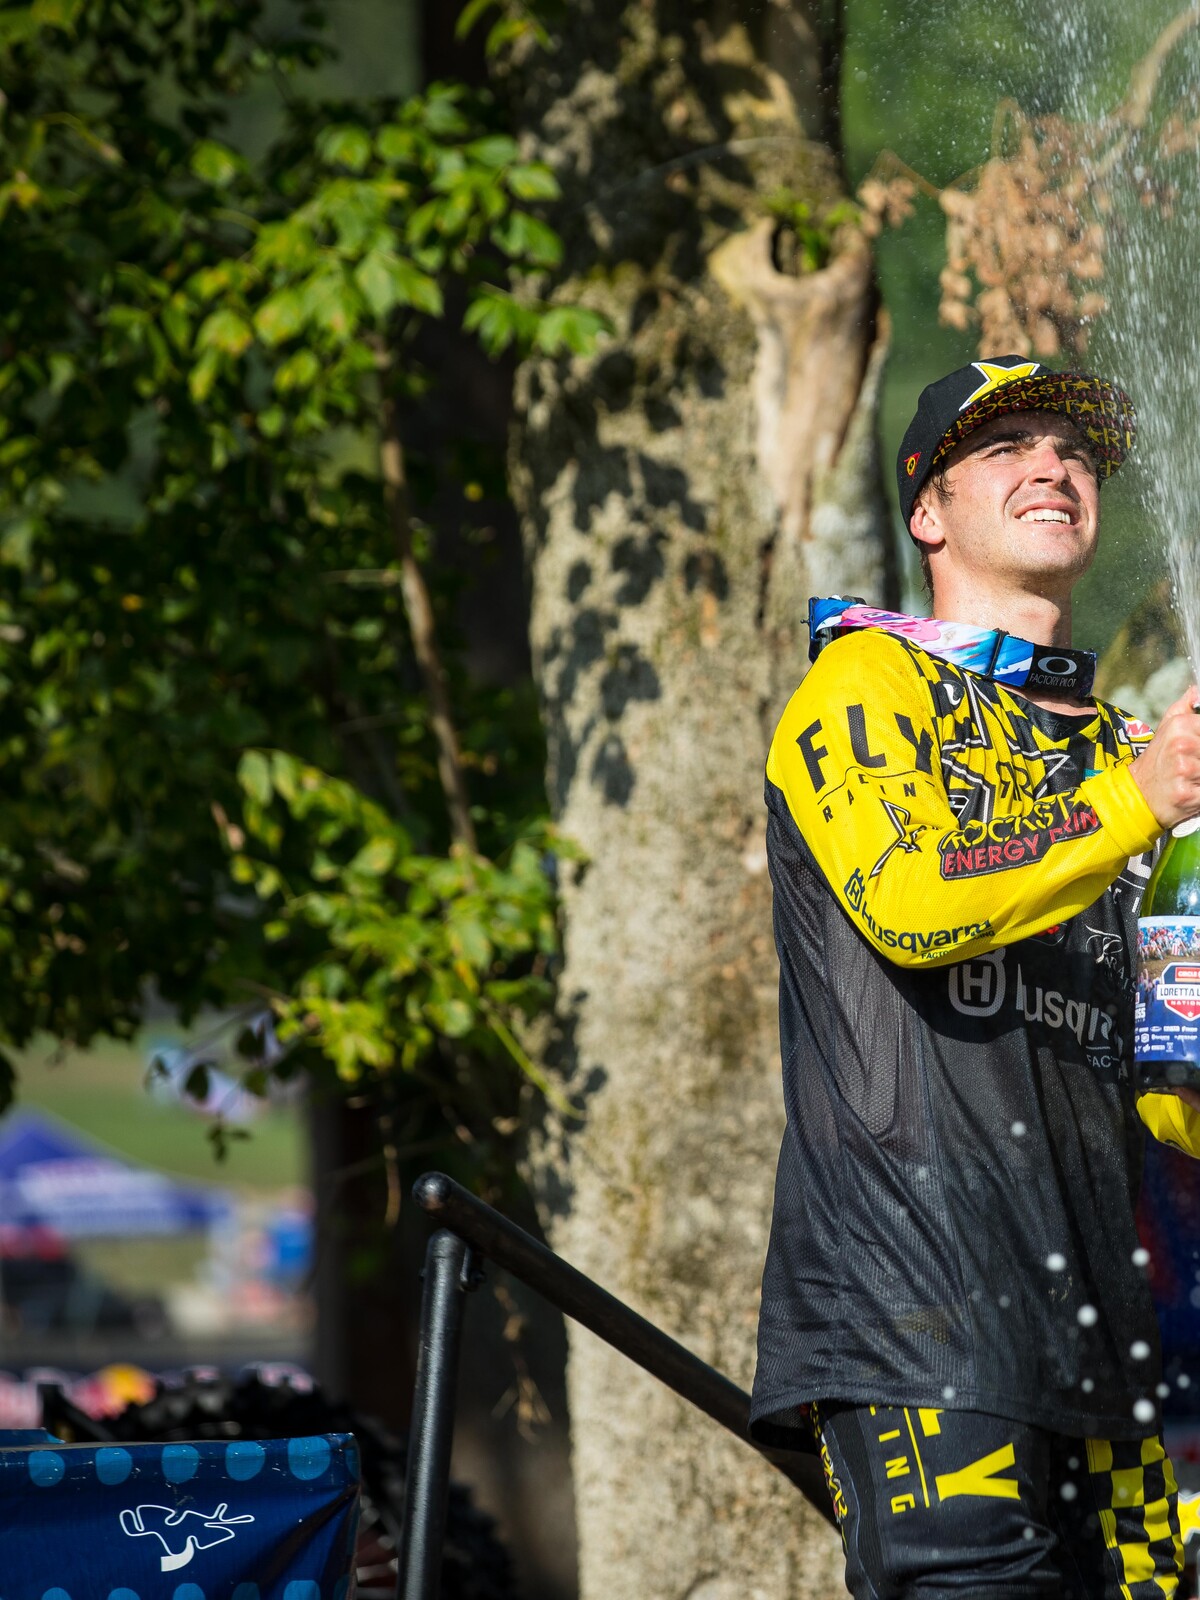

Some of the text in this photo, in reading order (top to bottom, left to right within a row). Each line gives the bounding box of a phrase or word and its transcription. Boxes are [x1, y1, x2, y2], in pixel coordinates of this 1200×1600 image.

[1029, 672, 1077, 688] FACTORY PILOT
[795, 703, 934, 794] FLY
[944, 833, 1040, 874] ENERGY
[1160, 987, 1195, 997] LORETTA
